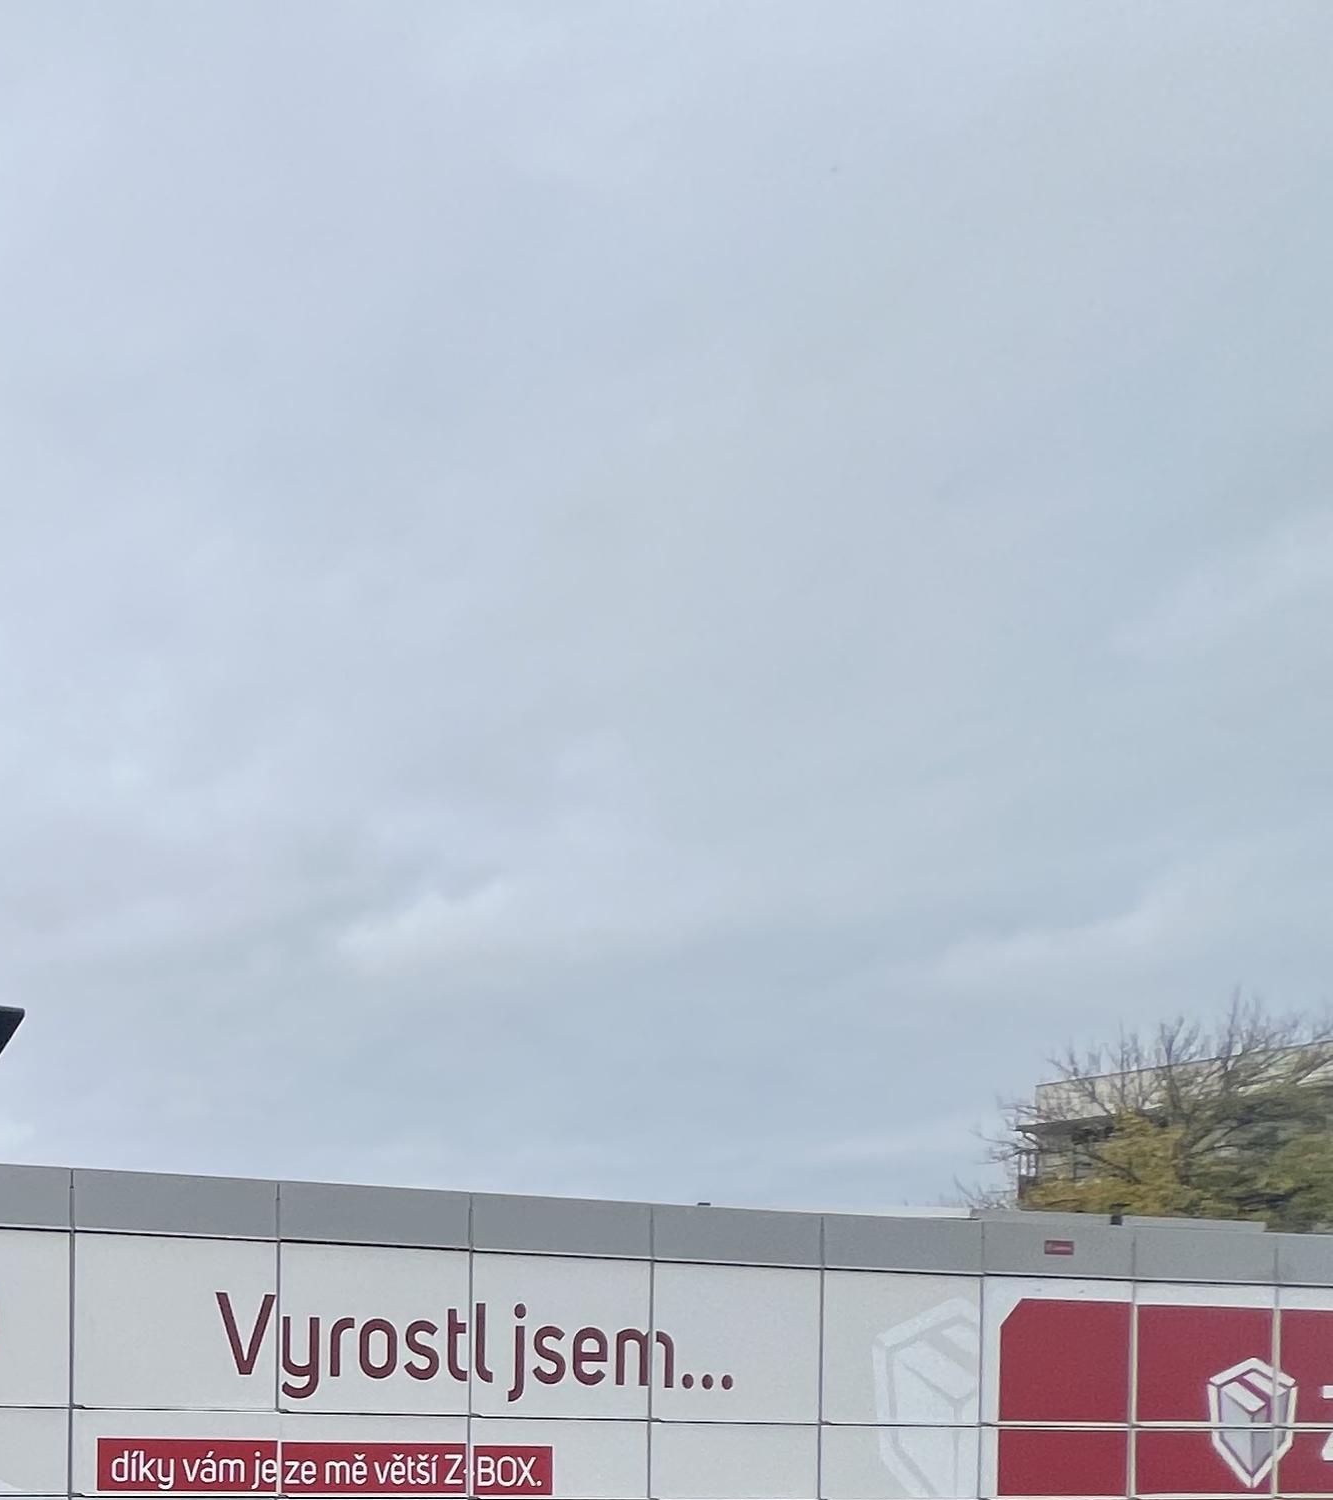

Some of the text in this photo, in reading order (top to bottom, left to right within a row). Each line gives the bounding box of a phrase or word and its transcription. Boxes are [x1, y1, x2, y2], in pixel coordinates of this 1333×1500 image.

[215, 1291, 494, 1400] Vyrostl
[111, 1448, 543, 1491] díky vám je ze mě větší Z-BOX.
